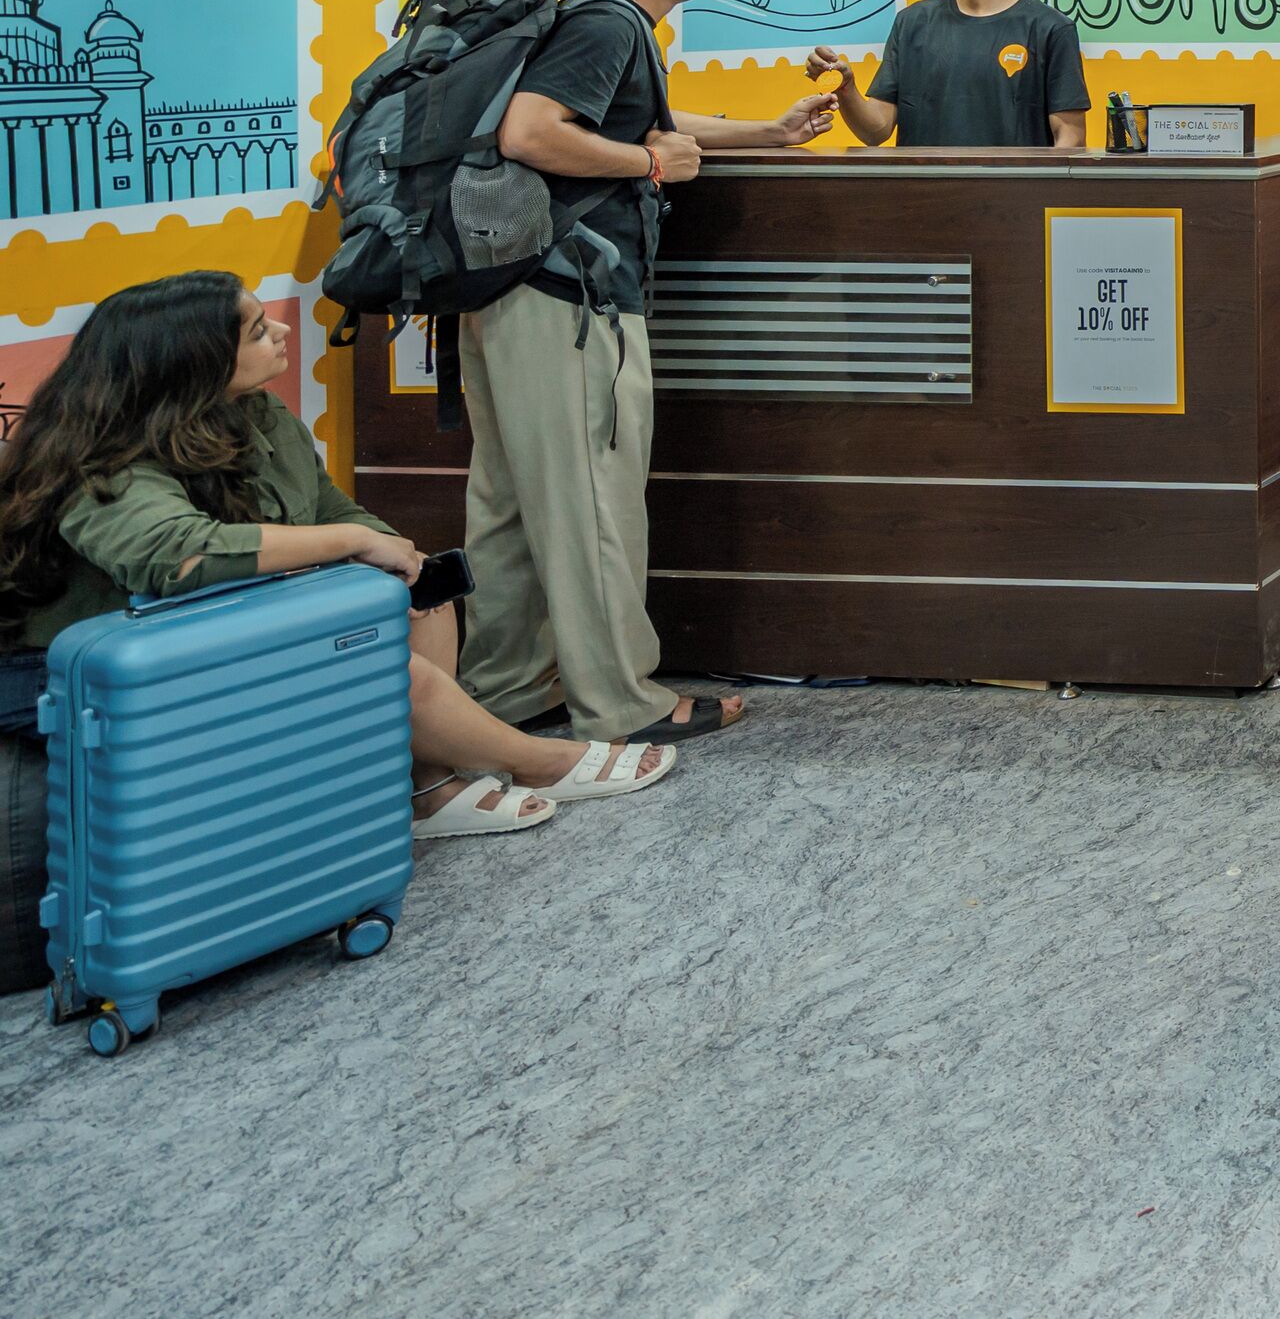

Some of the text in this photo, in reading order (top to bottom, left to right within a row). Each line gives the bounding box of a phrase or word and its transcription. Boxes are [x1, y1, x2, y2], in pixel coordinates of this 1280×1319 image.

[1154, 120, 1172, 129] THE
[1212, 121, 1239, 130] STAYS
[1097, 279, 1128, 303] GET
[1077, 306, 1149, 331] 10% OFF
